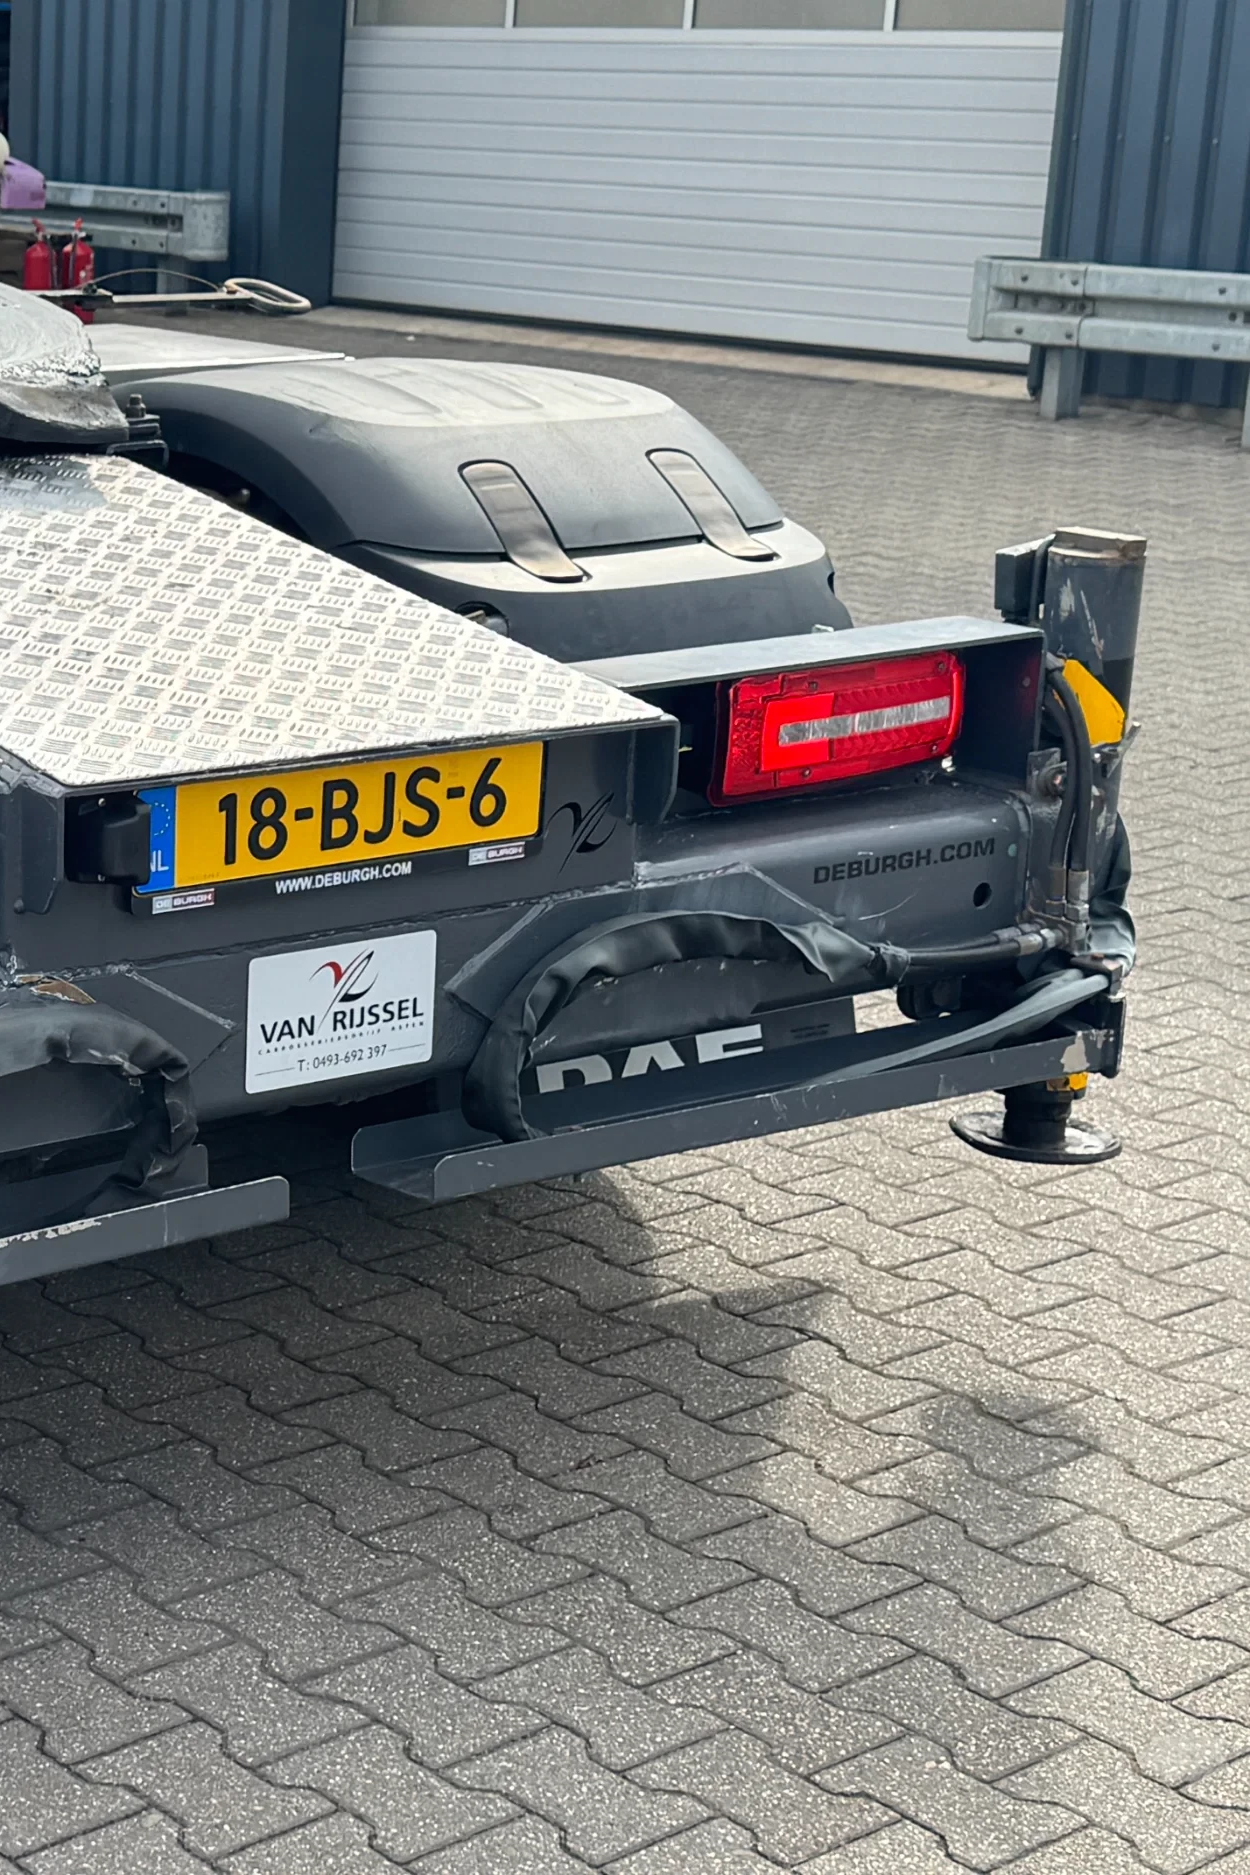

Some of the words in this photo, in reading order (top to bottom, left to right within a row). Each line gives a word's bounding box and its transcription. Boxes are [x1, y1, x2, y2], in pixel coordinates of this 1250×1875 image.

[218, 757, 507, 866] 18-BJS-6
[275, 861, 412, 894] WWW.DEBURGH.COM
[813, 837, 996, 884] DEBURGH.COM
[260, 1014, 315, 1044] VAN
[333, 997, 424, 1032] RIJSSEL
[297, 1058, 310, 1072] T:
[312, 1049, 364, 1069] 0493-692
[367, 1044, 387, 1059] 397
